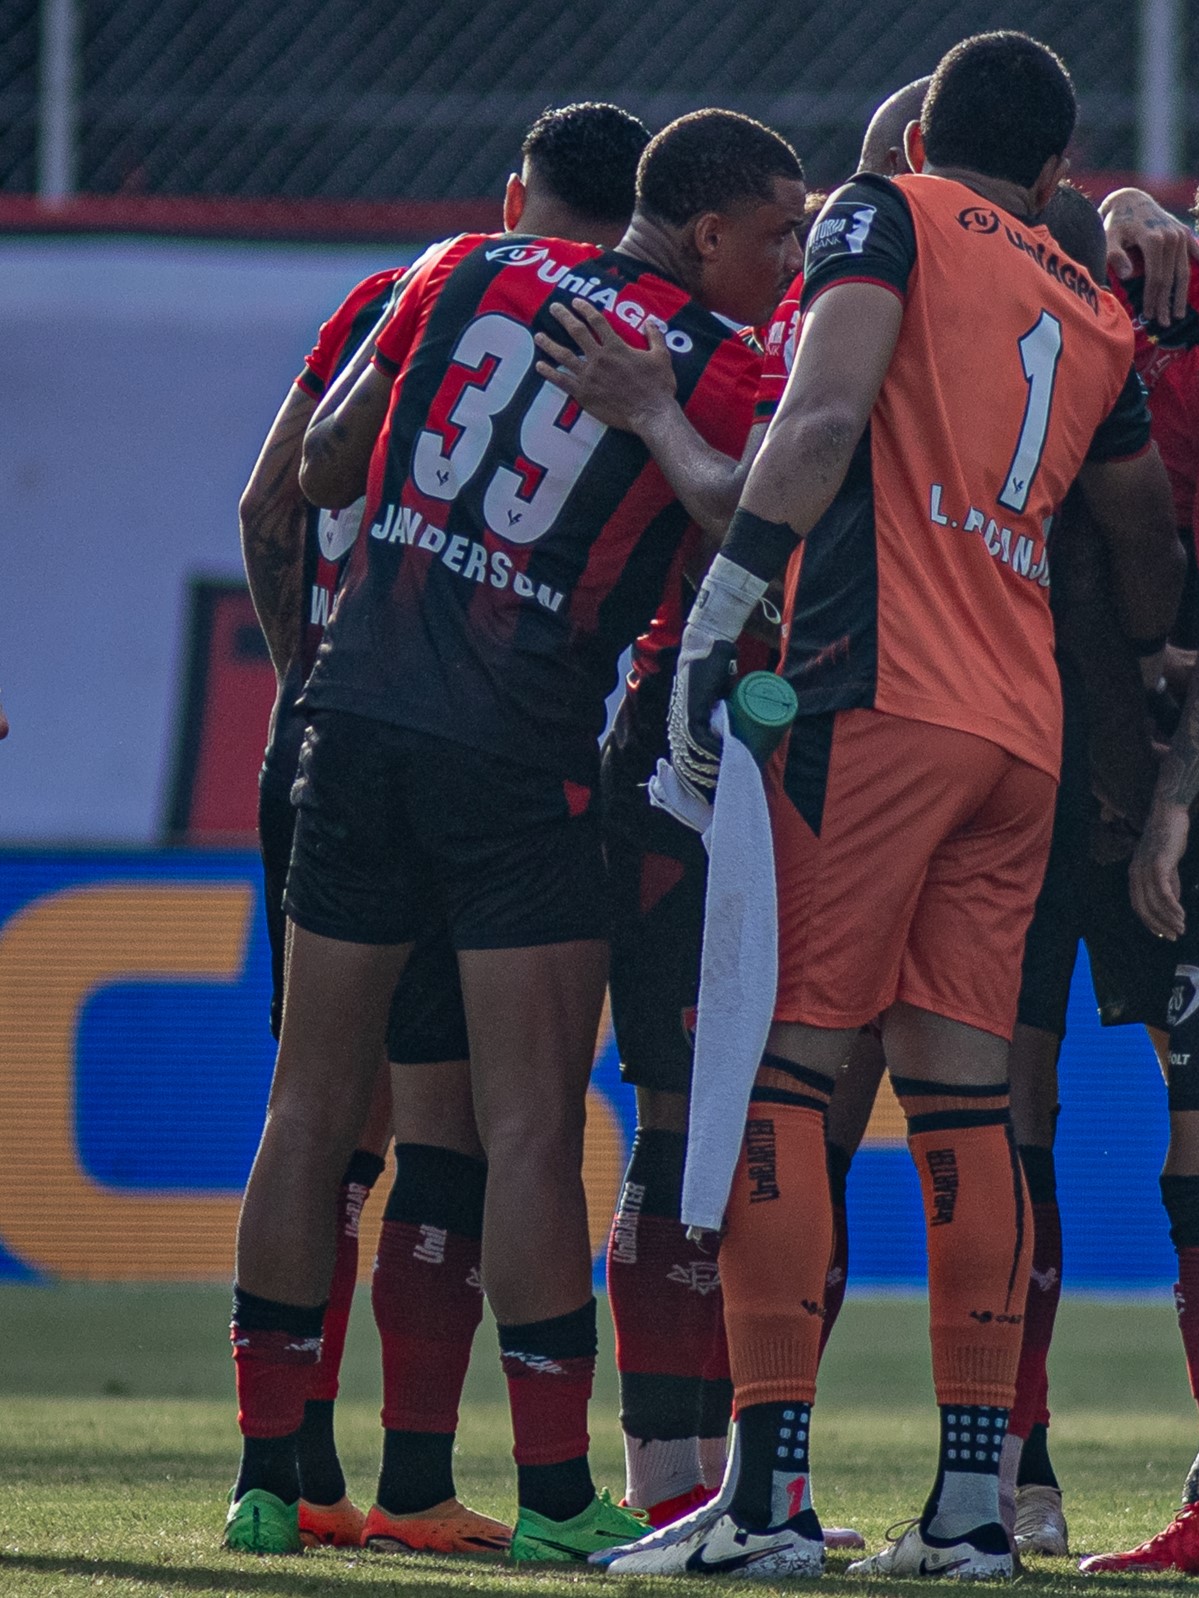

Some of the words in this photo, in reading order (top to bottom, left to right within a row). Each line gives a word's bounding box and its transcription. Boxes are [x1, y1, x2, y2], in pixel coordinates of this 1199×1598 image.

[412, 313, 610, 544] 39
[997, 308, 1063, 514] 1
[371, 504, 564, 612] JANDERSON
[1168, 1052, 1191, 1066] OLT
